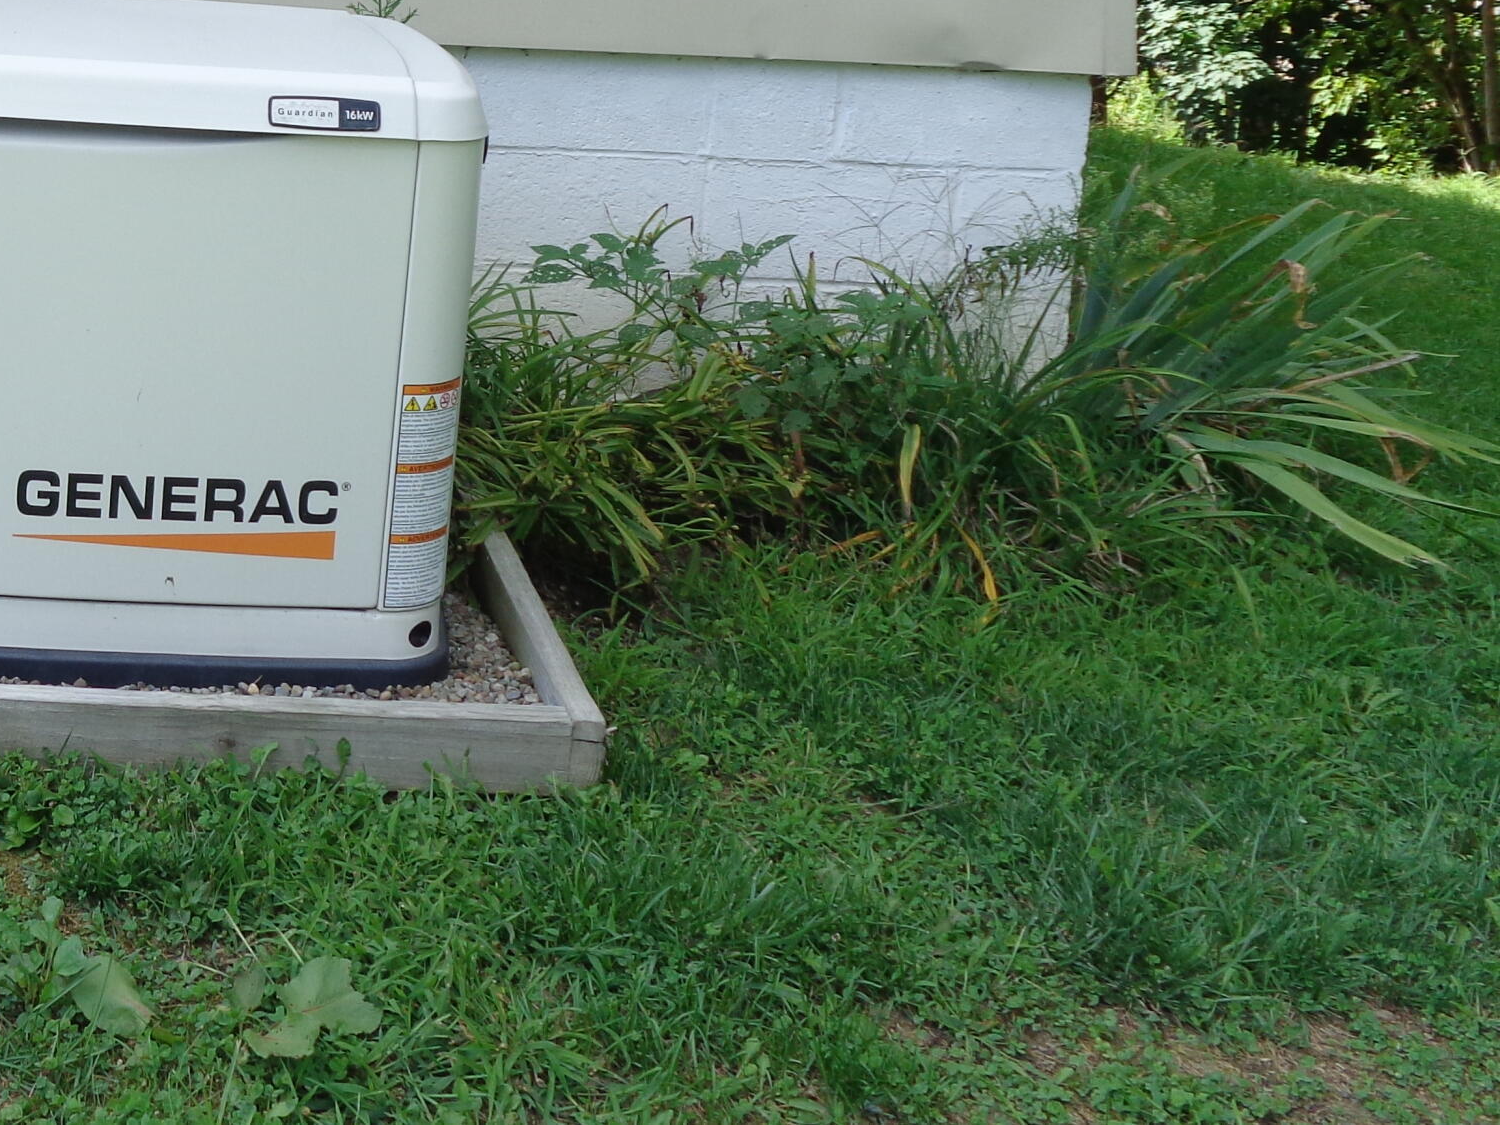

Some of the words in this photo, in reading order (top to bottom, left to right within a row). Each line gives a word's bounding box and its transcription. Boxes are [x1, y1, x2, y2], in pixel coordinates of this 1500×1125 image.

[277, 107, 333, 118] Guardian
[345, 110, 374, 121] 16kW
[16, 470, 339, 525] GENERAC
